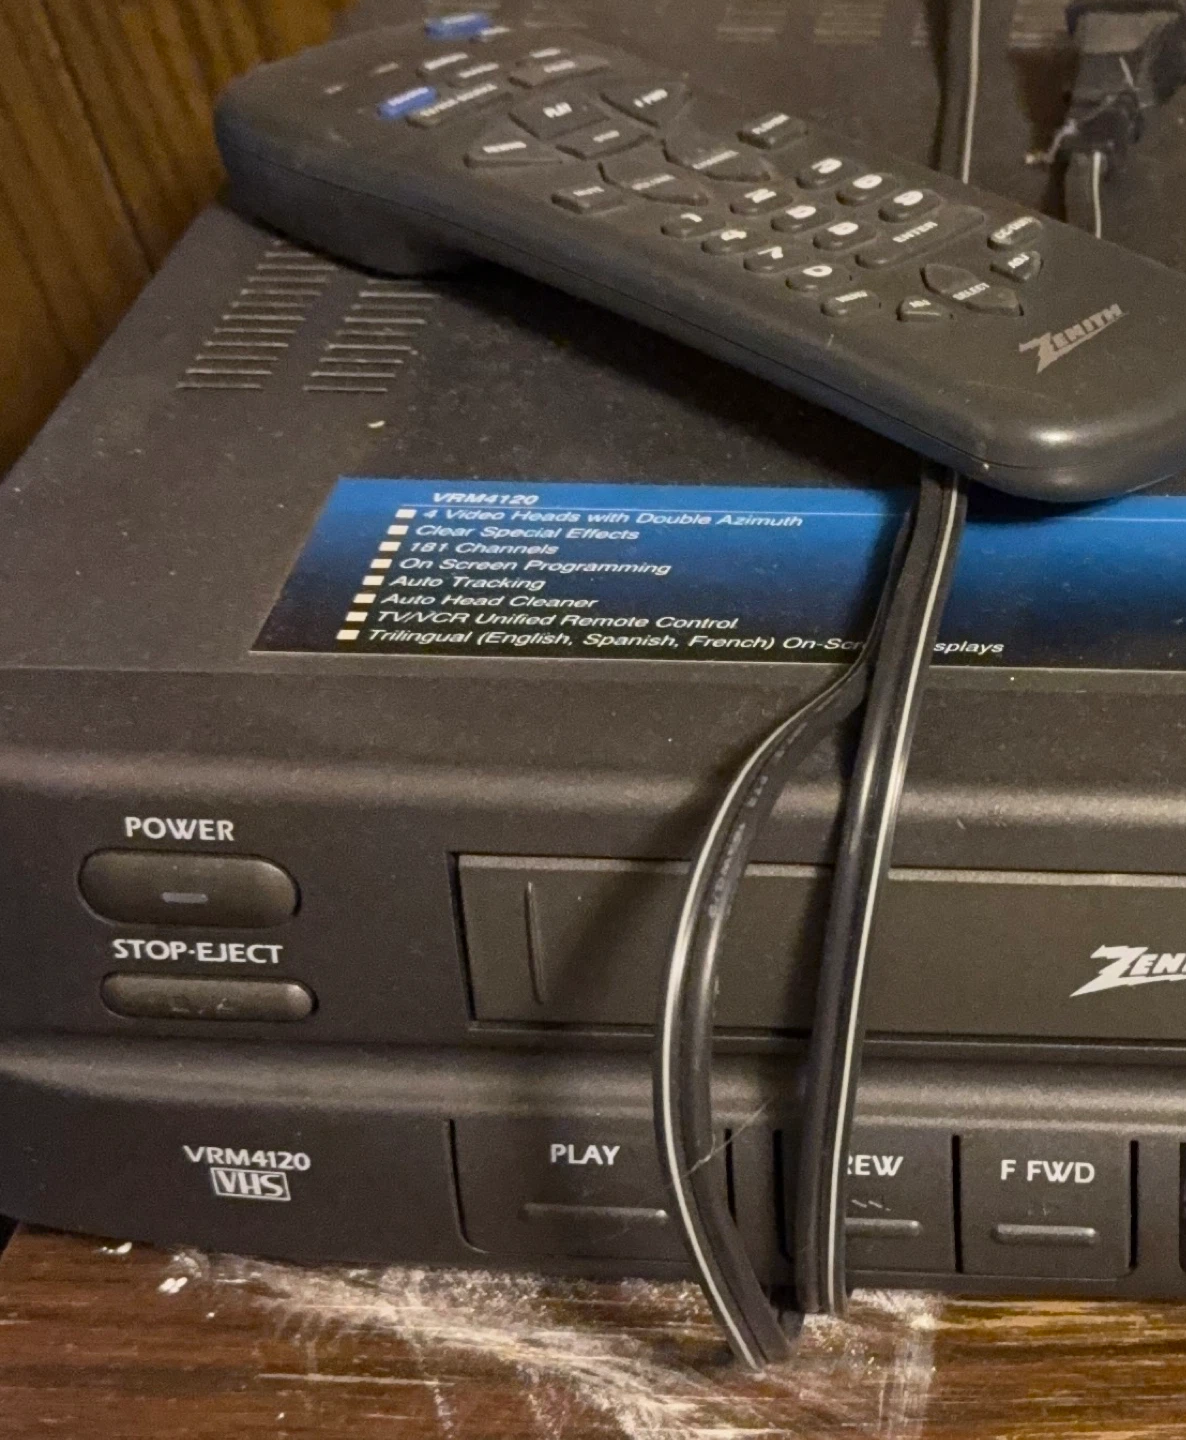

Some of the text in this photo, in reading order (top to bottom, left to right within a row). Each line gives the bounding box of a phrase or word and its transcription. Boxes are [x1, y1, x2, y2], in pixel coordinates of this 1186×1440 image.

[811, 158, 842, 174] 3
[744, 188, 776, 203] 2
[680, 212, 702, 222] 1
[720, 229, 747, 241] 4
[893, 221, 938, 242] ENTER
[757, 246, 783, 259] 7
[802, 265, 833, 277] 0
[952, 282, 990, 300] SELECT
[1018, 303, 1123, 374] ZENITH
[432, 492, 540, 505] VRM4120
[423, 510, 803, 527] 4 Video Heads with Double Azimuth
[415, 525, 640, 540] Clear Special Effects
[410, 542, 559, 555] 181 Channels
[400, 558, 672, 576] On Screen Programming
[388, 575, 546, 591] Auto Tracking
[380, 593, 599, 608] Auto Head Cleaner
[377, 611, 739, 630] TV/VCR Unified Remote Control
[368, 629, 1005, 655] Trilingual (English, Spanish, French) On-Scr splays
[124, 816, 234, 841] POWER
[183, 1144, 311, 1171] VRM4120
[550, 1143, 620, 1166] PLAY
[1000, 1159, 1096, 1184] F FWD
[212, 1168, 288, 1199] VHS
